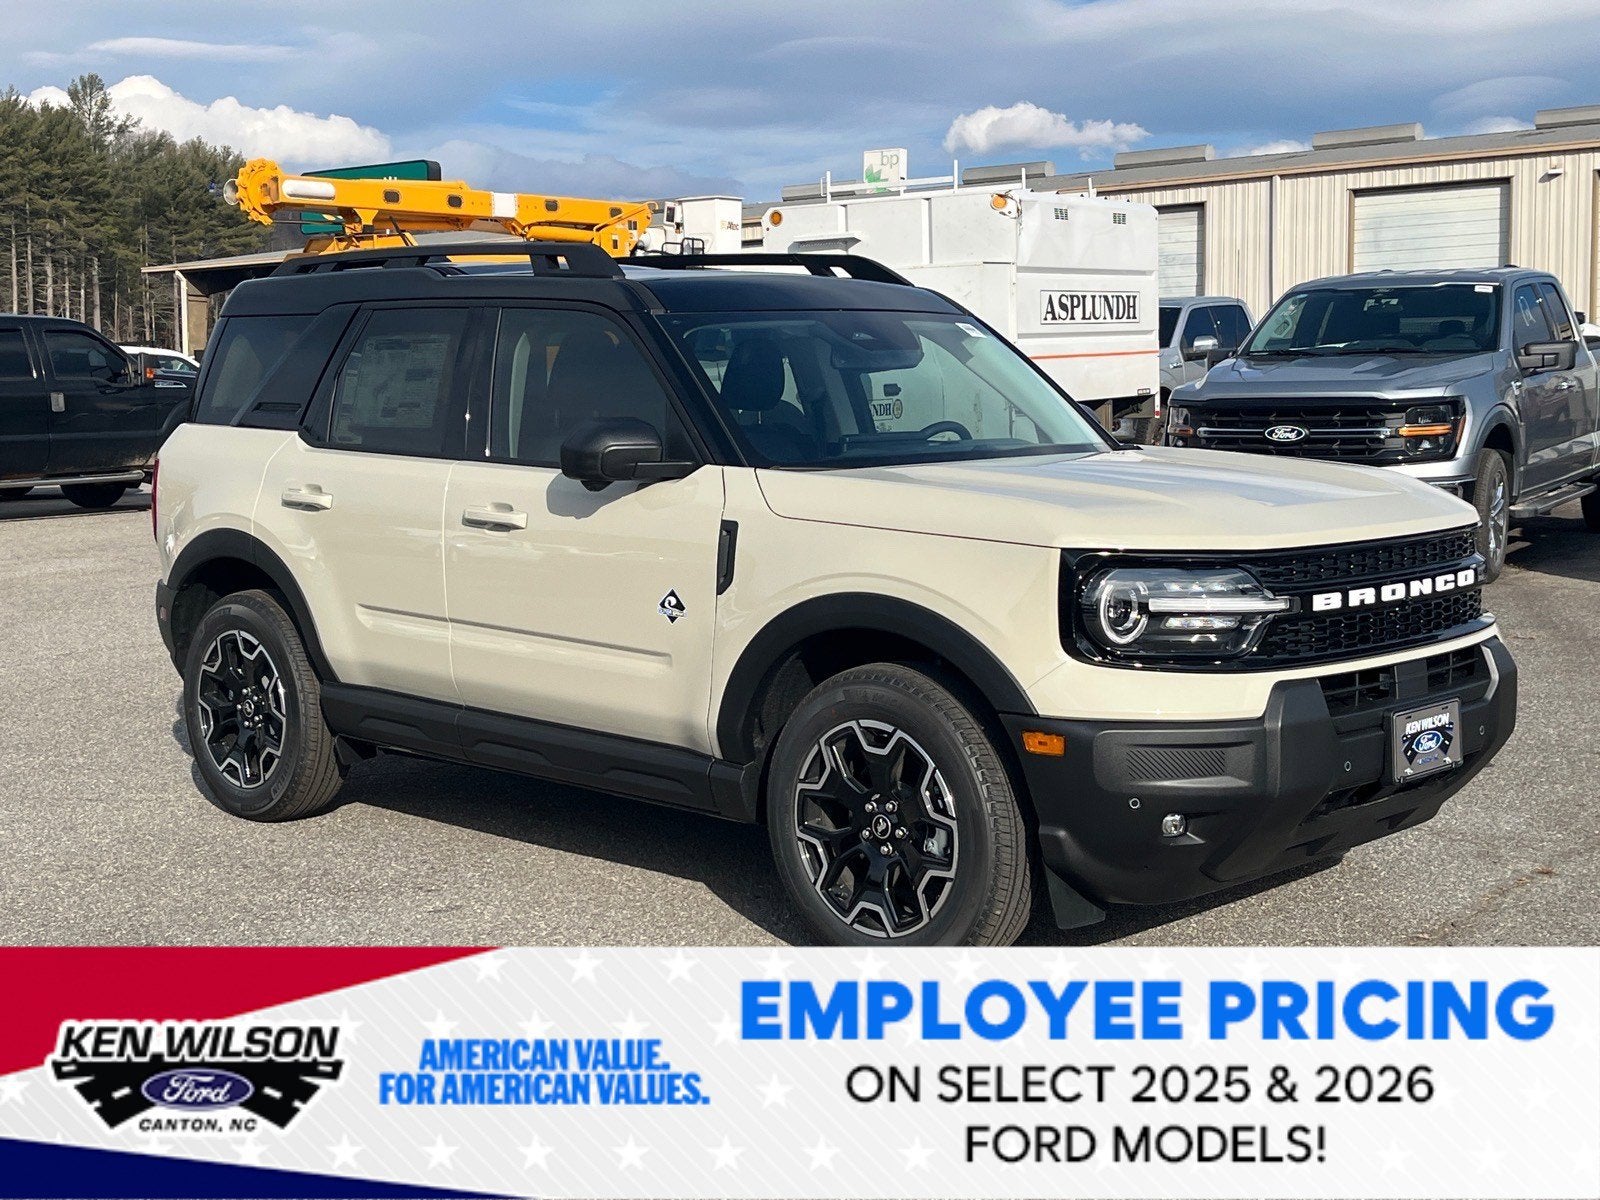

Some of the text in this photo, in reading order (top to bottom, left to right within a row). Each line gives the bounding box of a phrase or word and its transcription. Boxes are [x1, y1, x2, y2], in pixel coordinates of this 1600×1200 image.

[881, 151, 899, 169] bp
[1043, 293, 1138, 321] ASPLUNDH
[1272, 428, 1298, 439] Ford
[1312, 568, 1475, 612] BRONCO
[1405, 712, 1450, 735] KEN WILSON
